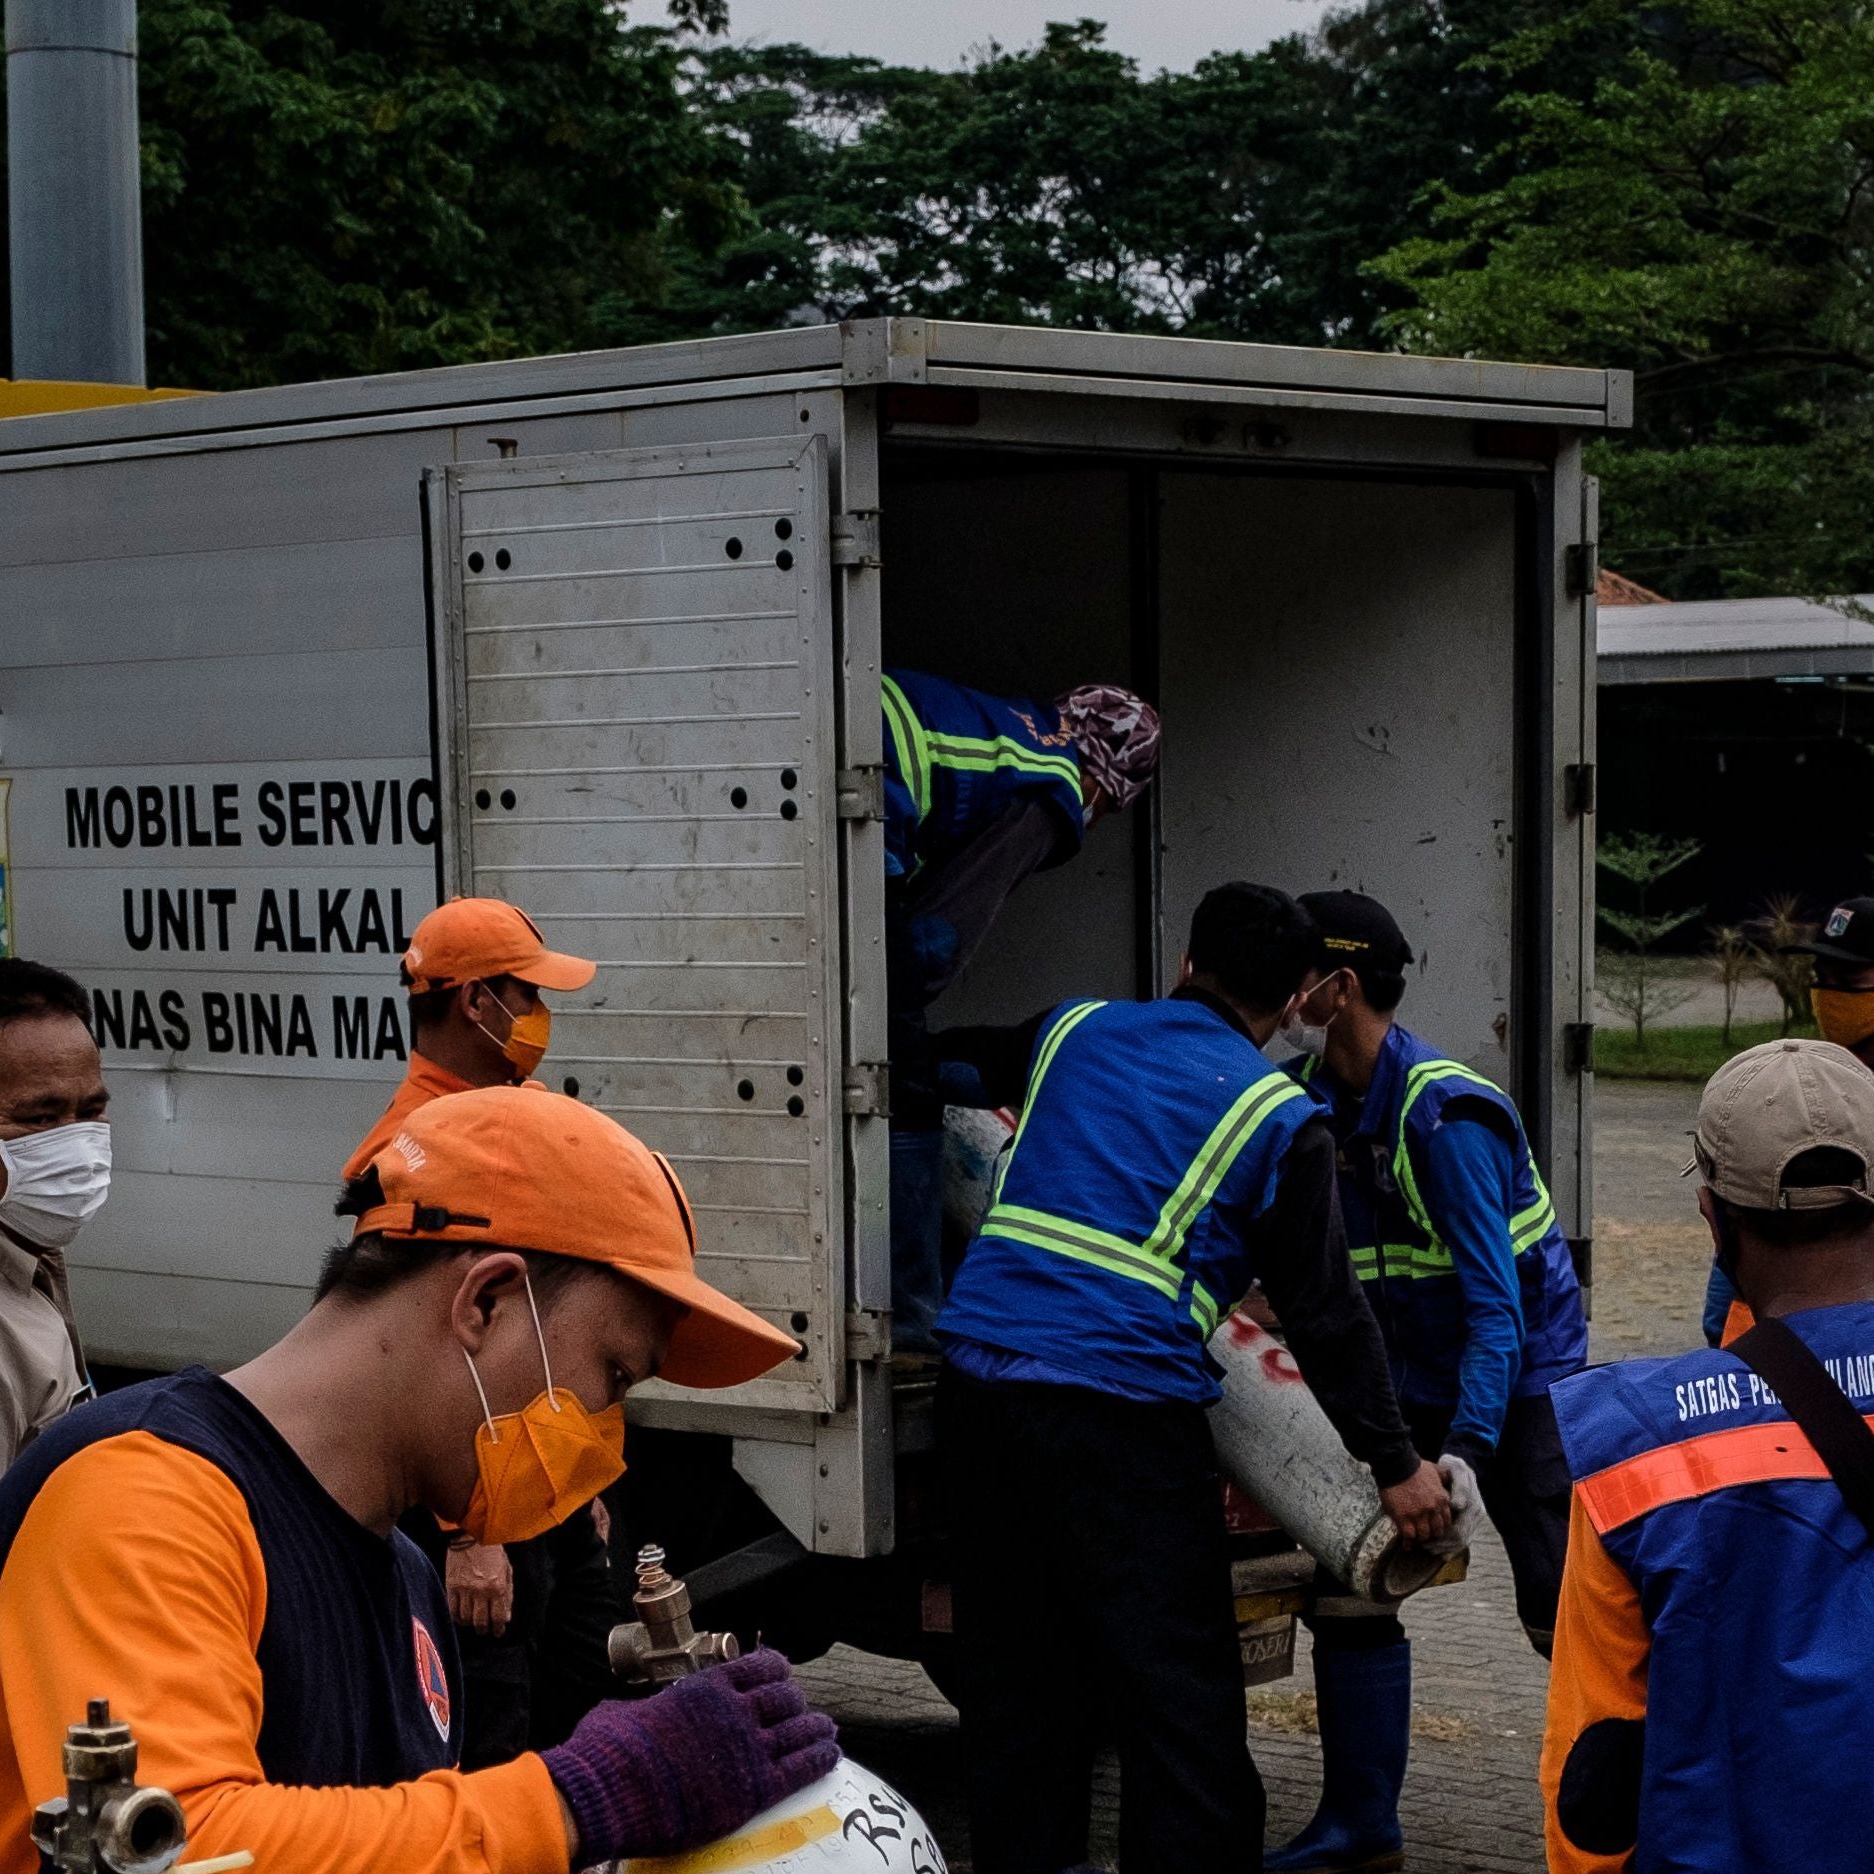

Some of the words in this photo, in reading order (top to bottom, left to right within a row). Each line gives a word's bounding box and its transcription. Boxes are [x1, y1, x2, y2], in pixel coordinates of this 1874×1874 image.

[66, 784, 242, 848] MOBILE
[124, 888, 236, 951] UNIT
[203, 991, 318, 1058] BINA
[333, 995, 415, 1061] MA
[1676, 1372, 1740, 1422] SATGAS
